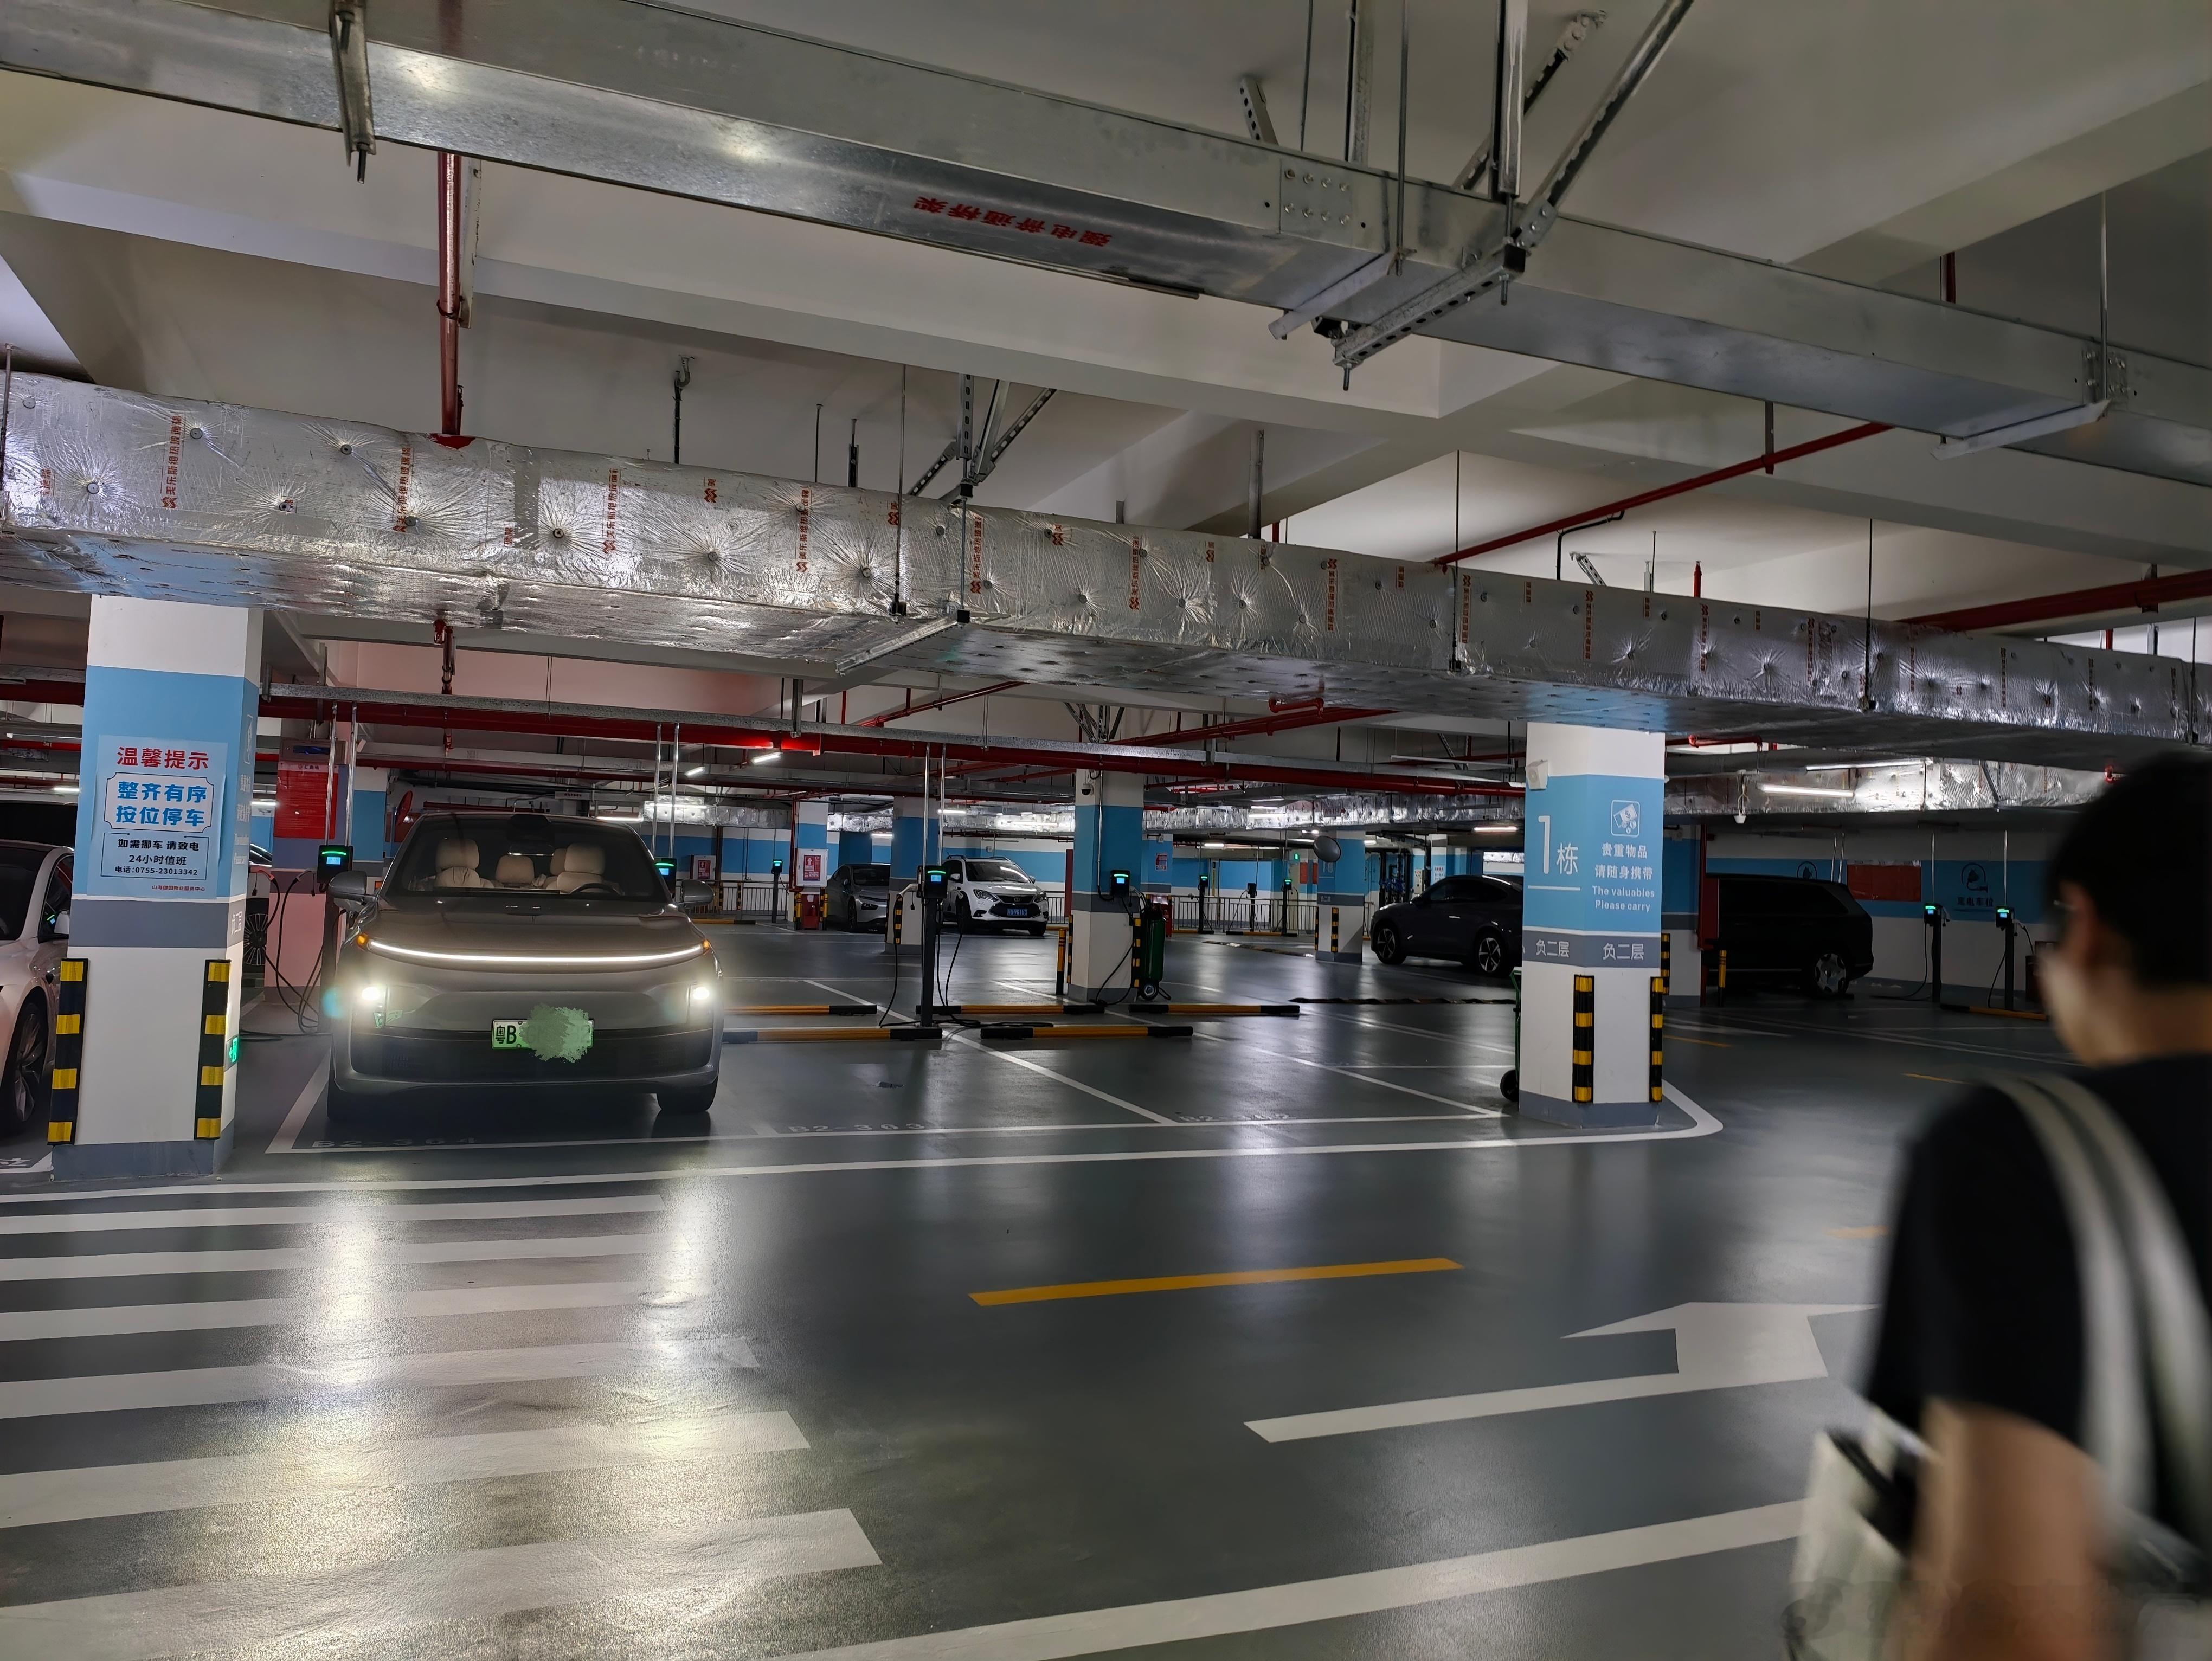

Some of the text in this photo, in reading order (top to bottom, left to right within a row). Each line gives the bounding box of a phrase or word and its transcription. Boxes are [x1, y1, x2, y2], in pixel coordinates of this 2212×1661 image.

[117, 746, 209, 770] 温馨提示
[117, 781, 207, 803] 整齐有序
[116, 805, 205, 827] 按位停车
[118, 838, 200, 851] 如需挪车 请致电
[1602, 843, 1648, 859] 贵重物品
[128, 854, 187, 865] 24小时值班
[1594, 864, 1653, 880] 请随身携带
[1592, 886, 1655, 898] The valuables
[1596, 900, 1650, 913] Please carry
[1535, 939, 1570, 958] 负二层
[1603, 943, 1644, 961] 负二层
